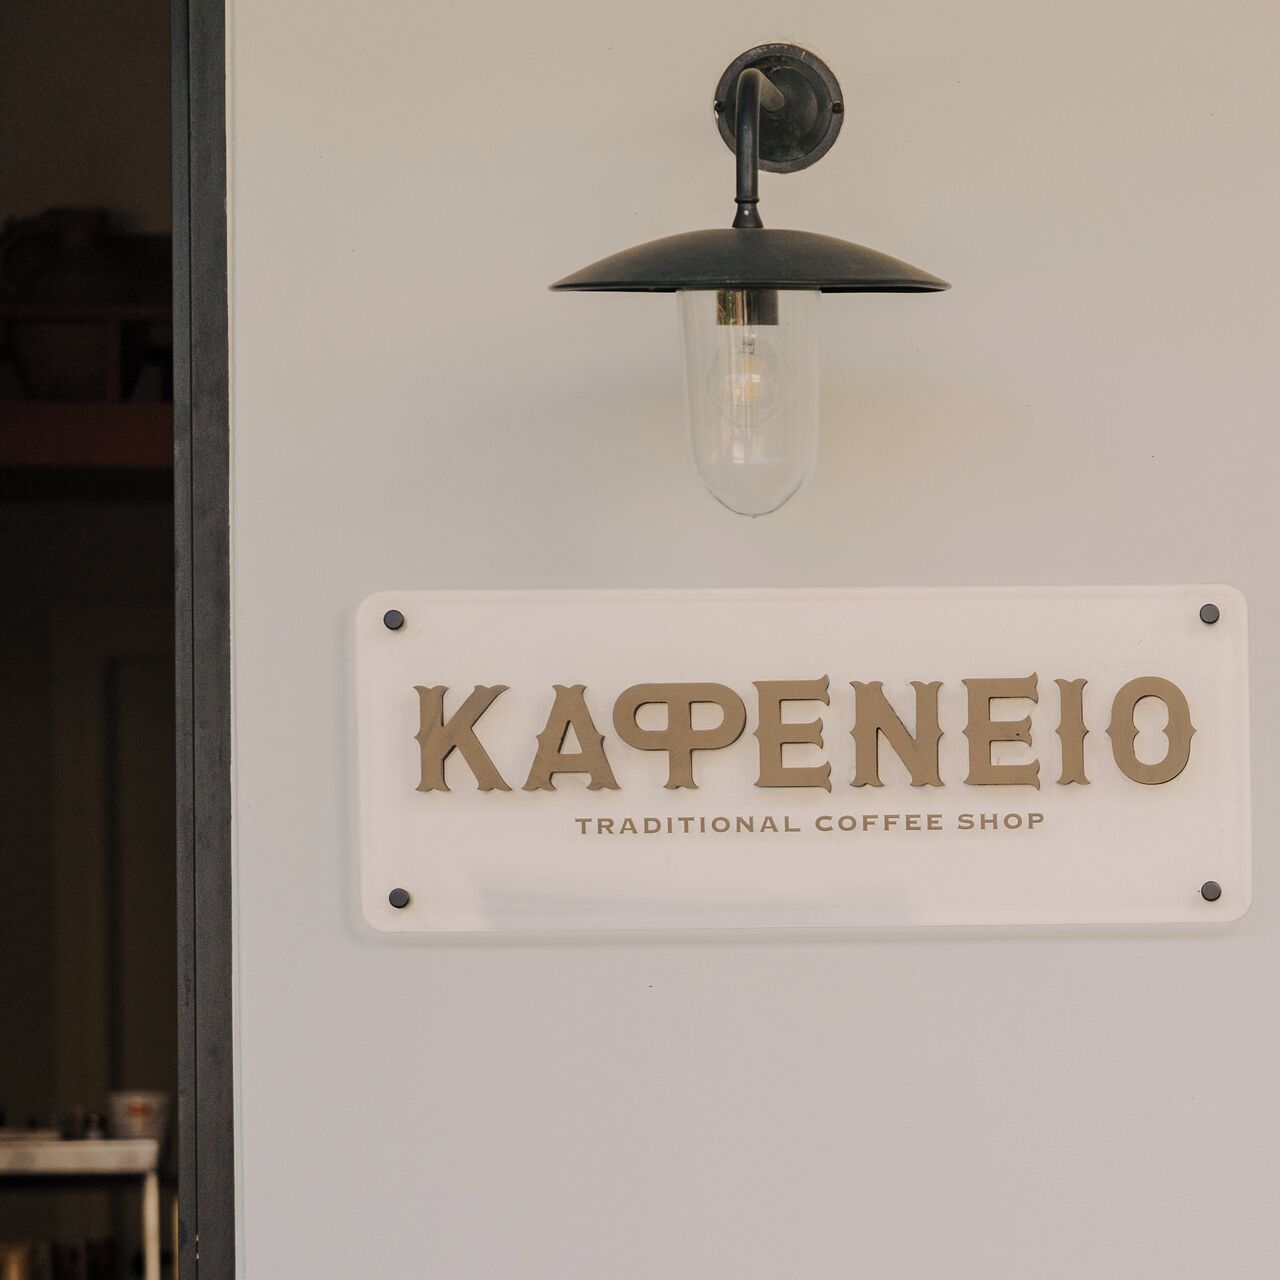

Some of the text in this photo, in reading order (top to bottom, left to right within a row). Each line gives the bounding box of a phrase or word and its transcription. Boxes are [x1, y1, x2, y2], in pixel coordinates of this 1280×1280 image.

[413, 672, 1197, 793] ΚΑΦΕΝΕΙΟ
[575, 812, 1045, 835] TRADITIONAL COFFEE SHOP
